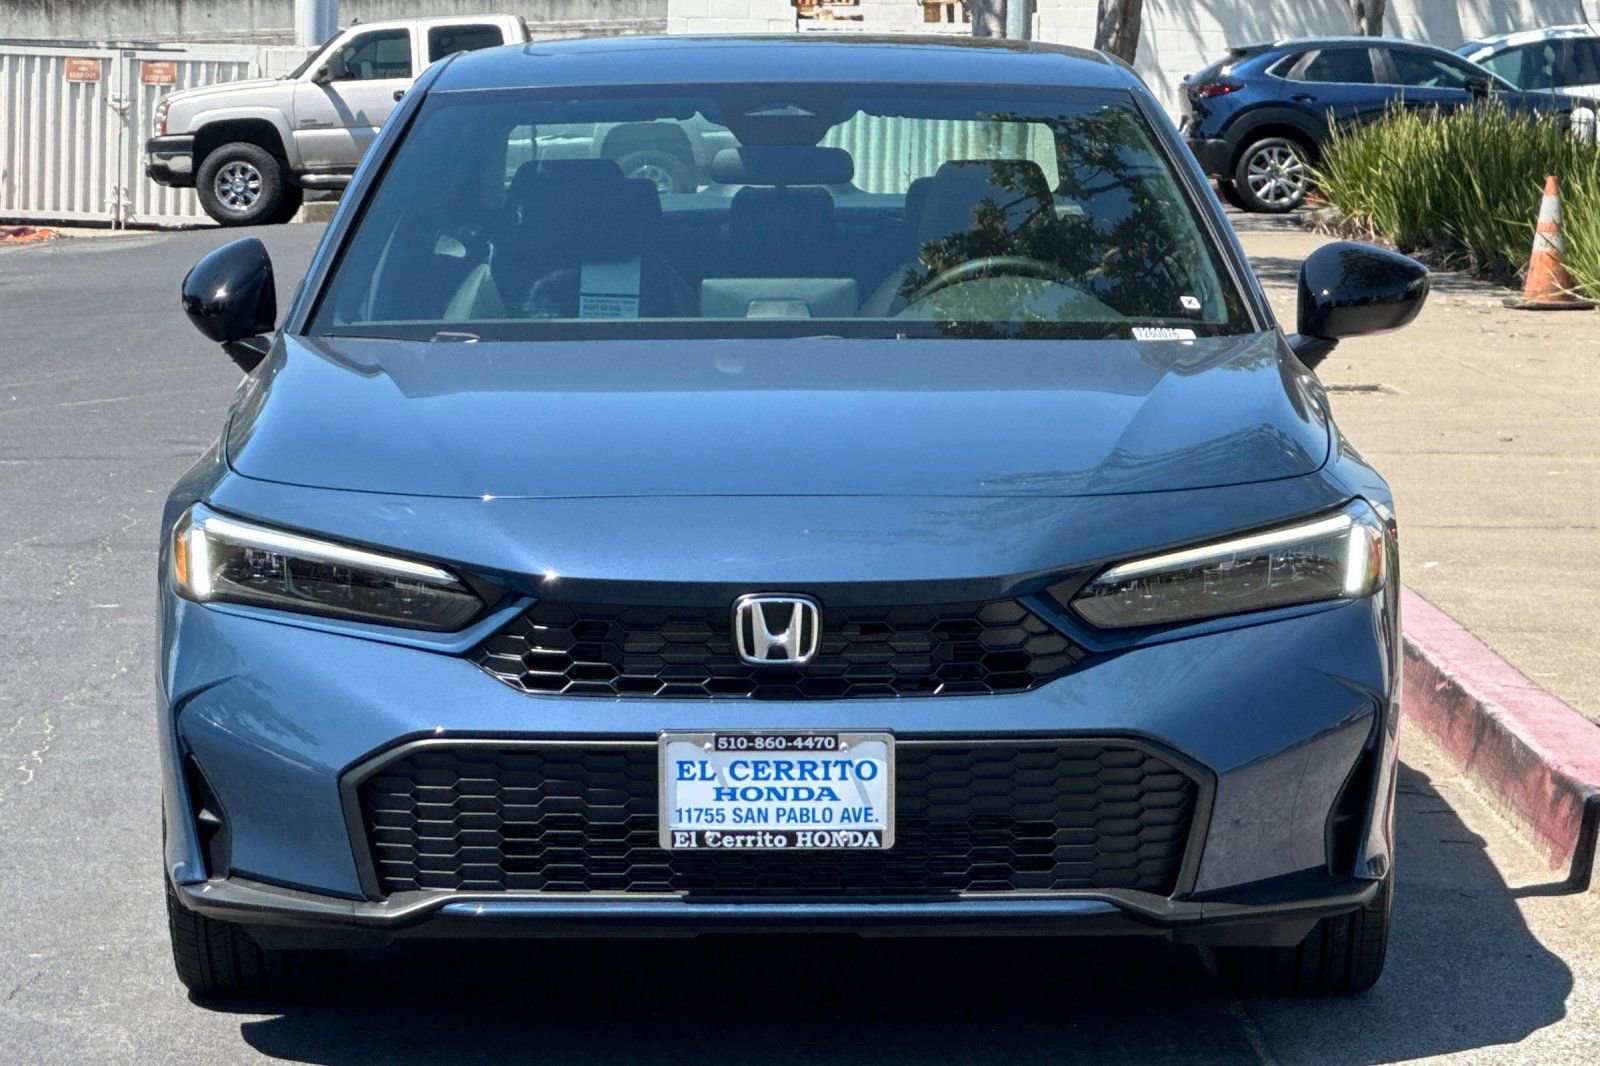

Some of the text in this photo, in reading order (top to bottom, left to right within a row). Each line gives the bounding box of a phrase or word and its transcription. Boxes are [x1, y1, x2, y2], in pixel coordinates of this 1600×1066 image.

[717, 736, 836, 749] 510-860-4470
[676, 760, 878, 782] EL CERRITO
[713, 786, 842, 802] HONDA
[675, 807, 880, 823] 11755 SAN PABLO AVE.
[674, 831, 880, 848] El Cerrito HONDA
